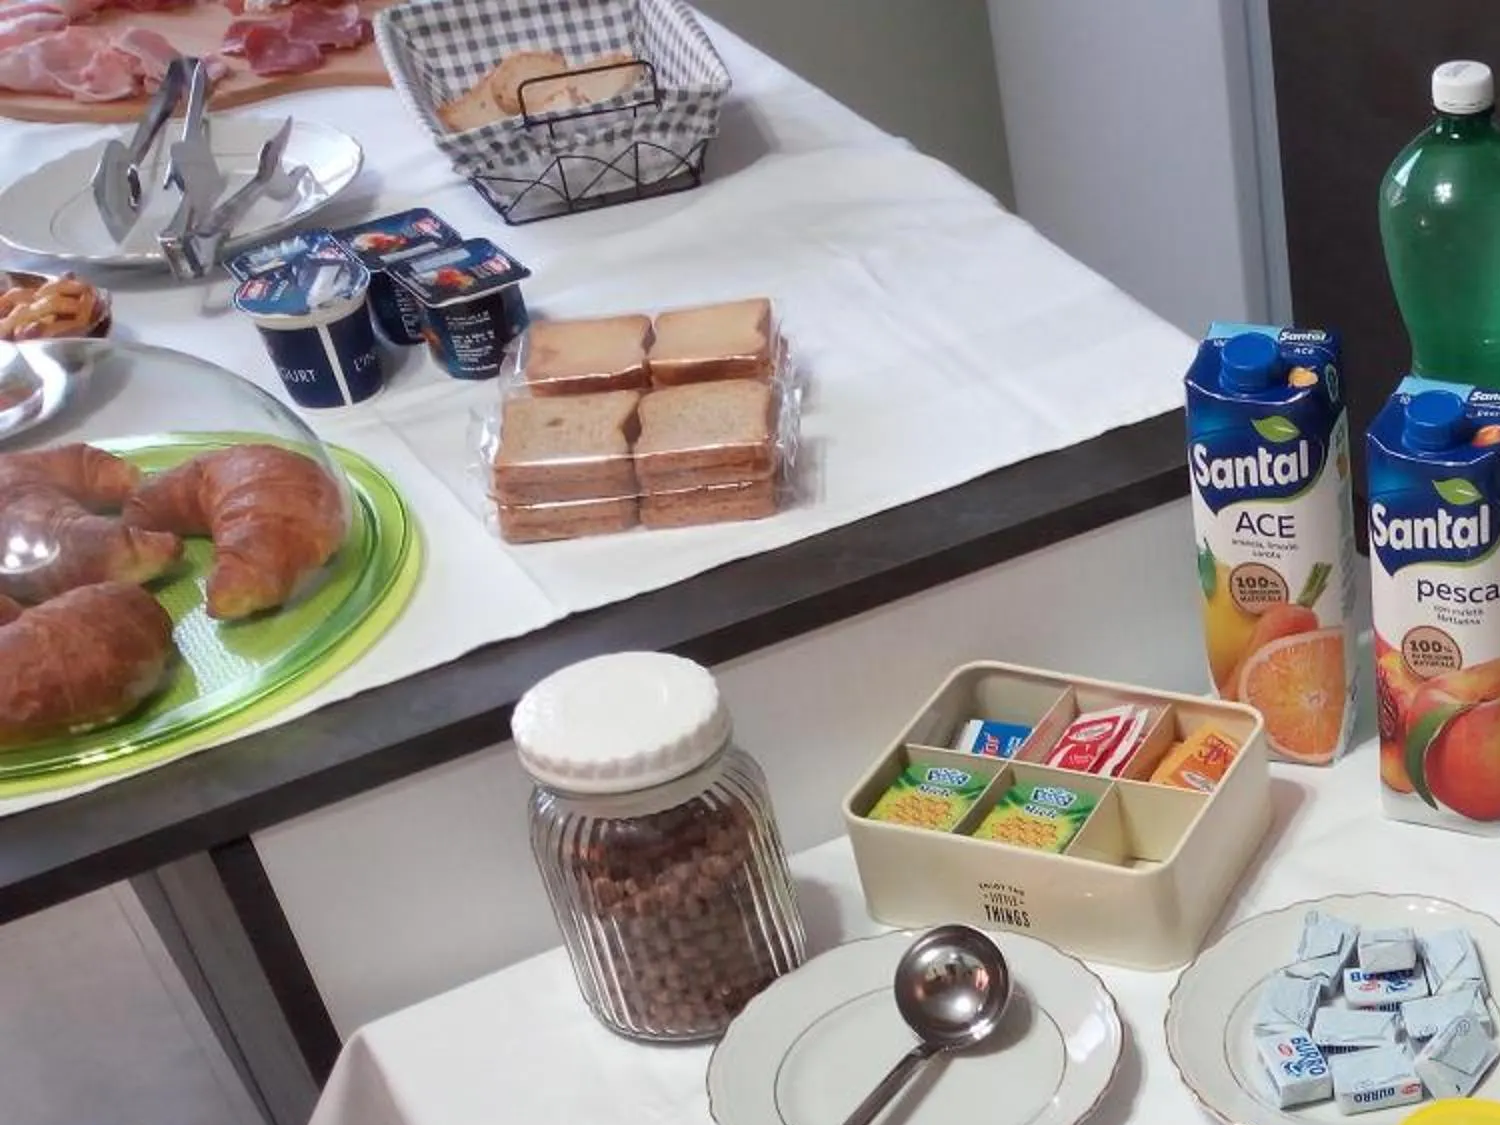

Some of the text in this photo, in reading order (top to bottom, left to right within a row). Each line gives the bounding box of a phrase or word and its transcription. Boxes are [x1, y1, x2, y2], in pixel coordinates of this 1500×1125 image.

[1192, 439, 1310, 490] Santal
[1235, 511, 1297, 539] ACE
[1371, 502, 1491, 551] Santal
[1417, 577, 1500, 604] pesca
[984, 903, 1031, 929] THINGS
[1290, 1036, 1327, 1077] BURRO
[1353, 1086, 1396, 1104] BURRO
